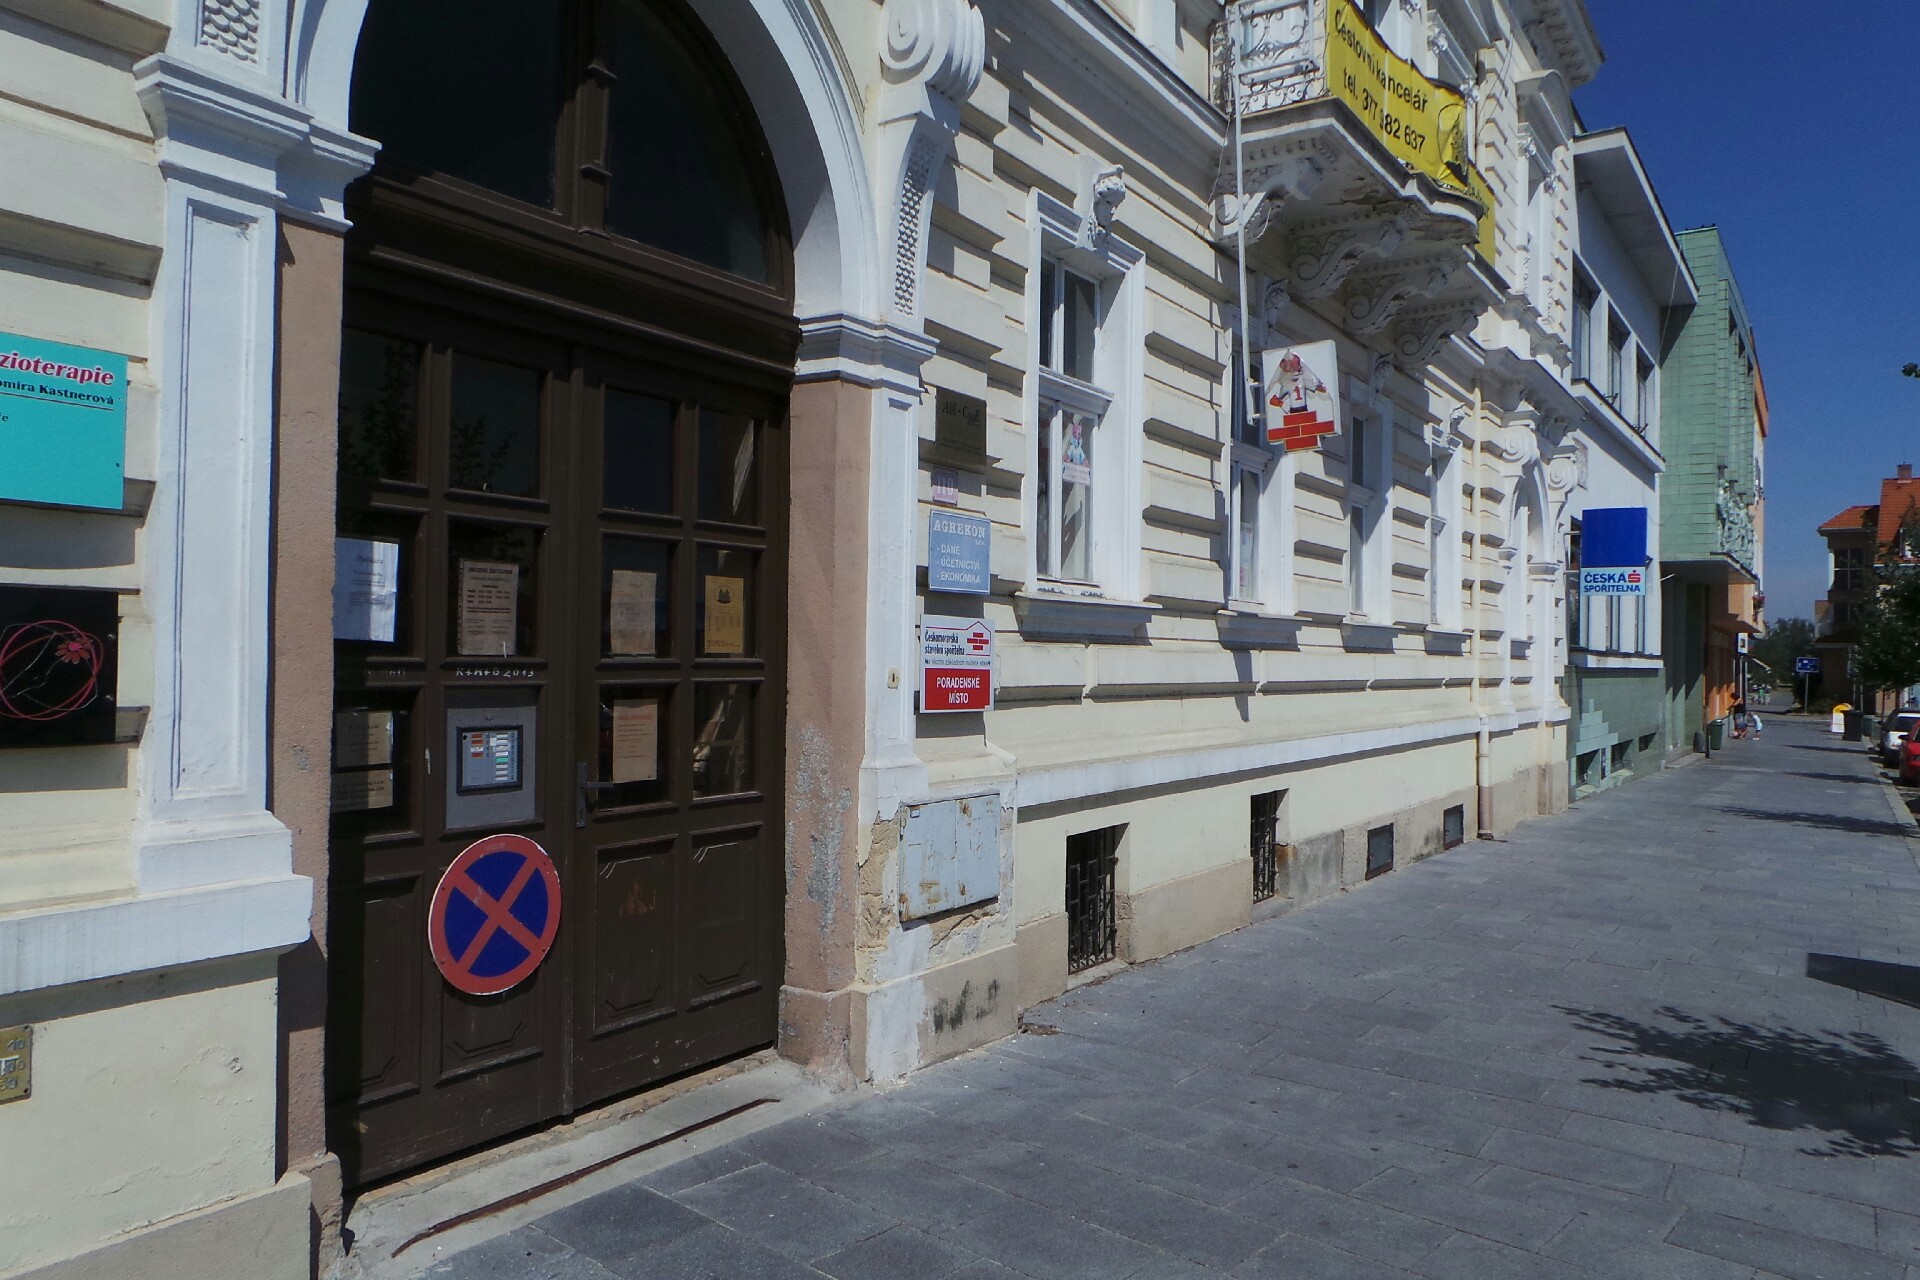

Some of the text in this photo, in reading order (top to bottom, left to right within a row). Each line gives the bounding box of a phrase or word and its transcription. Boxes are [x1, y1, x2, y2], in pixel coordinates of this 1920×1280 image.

[1376, 59, 1428, 113] kancelář
[1343, 66, 1358, 100] tel.
[1362, 88, 1379, 121] 377
[1404, 124, 1426, 153] 637
[39, 384, 114, 405] Kastnerová
[1292, 385, 1303, 401] 1
[937, 474, 955, 497] 110
[933, 519, 986, 538] AGREKON
[941, 571, 981, 584] EKONOMIKA
[1584, 571, 1627, 583] ČESKÁ
[1583, 583, 1641, 593] SPOŘITELNA
[936, 675, 980, 689] PORADENSKÉ
[948, 690, 969, 704] MÍSTO
